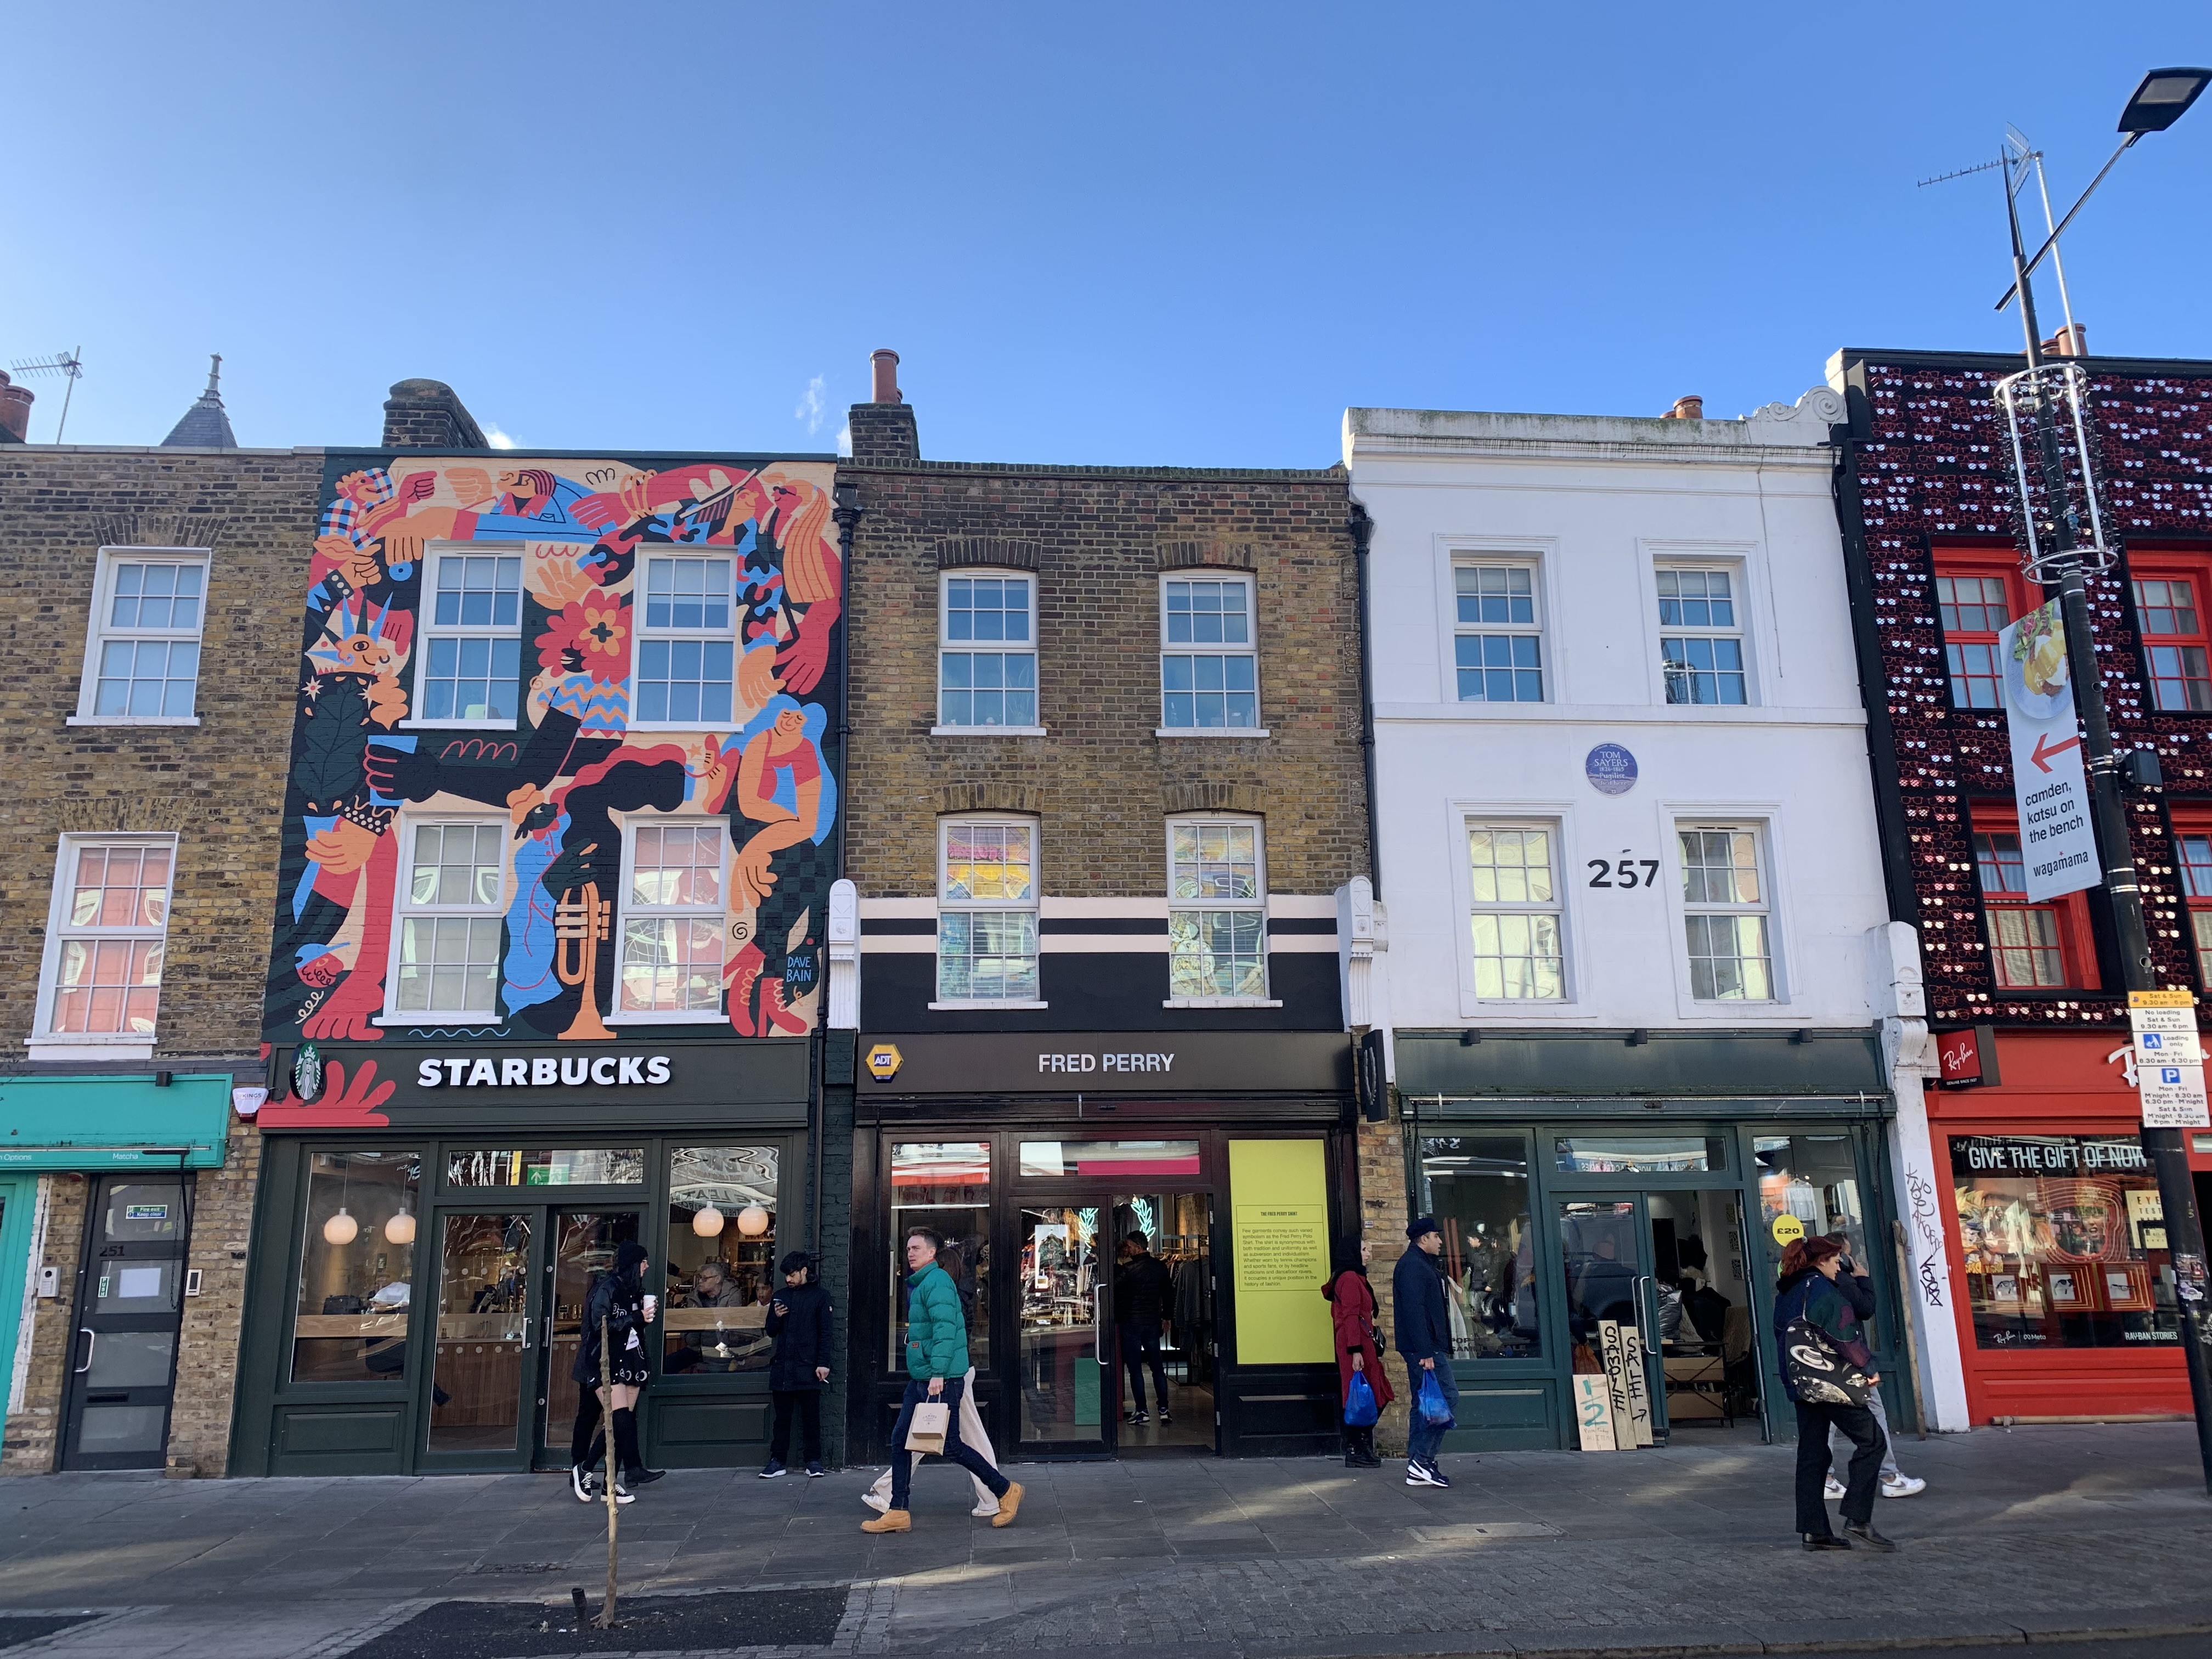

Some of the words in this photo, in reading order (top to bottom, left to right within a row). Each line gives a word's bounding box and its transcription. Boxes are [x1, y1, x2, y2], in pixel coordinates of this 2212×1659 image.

[2025, 782, 2072, 806] camden,
[2027, 805, 2057, 825] katsu
[2061, 799, 2075, 813] on
[2029, 829, 2047, 843] the
[2049, 815, 2084, 837] bench
[1587, 859, 1659, 889] 257
[2033, 851, 2089, 877] wagamama
[787, 956, 811, 968] DAVE
[786, 969, 811, 983] BAIN
[874, 1055, 891, 1065] ADT
[1038, 1054, 1096, 1073] FRED
[1103, 1053, 1175, 1072] PERRY
[417, 1056, 670, 1087] STARBUCKS
[2166, 1070, 2177, 1082] P
[4, 1154, 32, 1162] Options
[1968, 1147, 2007, 1169] GIVE
[2007, 1147, 2043, 1169] THE
[2045, 1147, 2080, 1169] GIFT
[2086, 1146, 2106, 1168] OF
[2108, 1146, 2147, 1168] NOW
[99, 1245, 125, 1257] 251
[2125, 1332, 2151, 1340] RAY-BAN
[2152, 1331, 2178, 1340] STORIES
